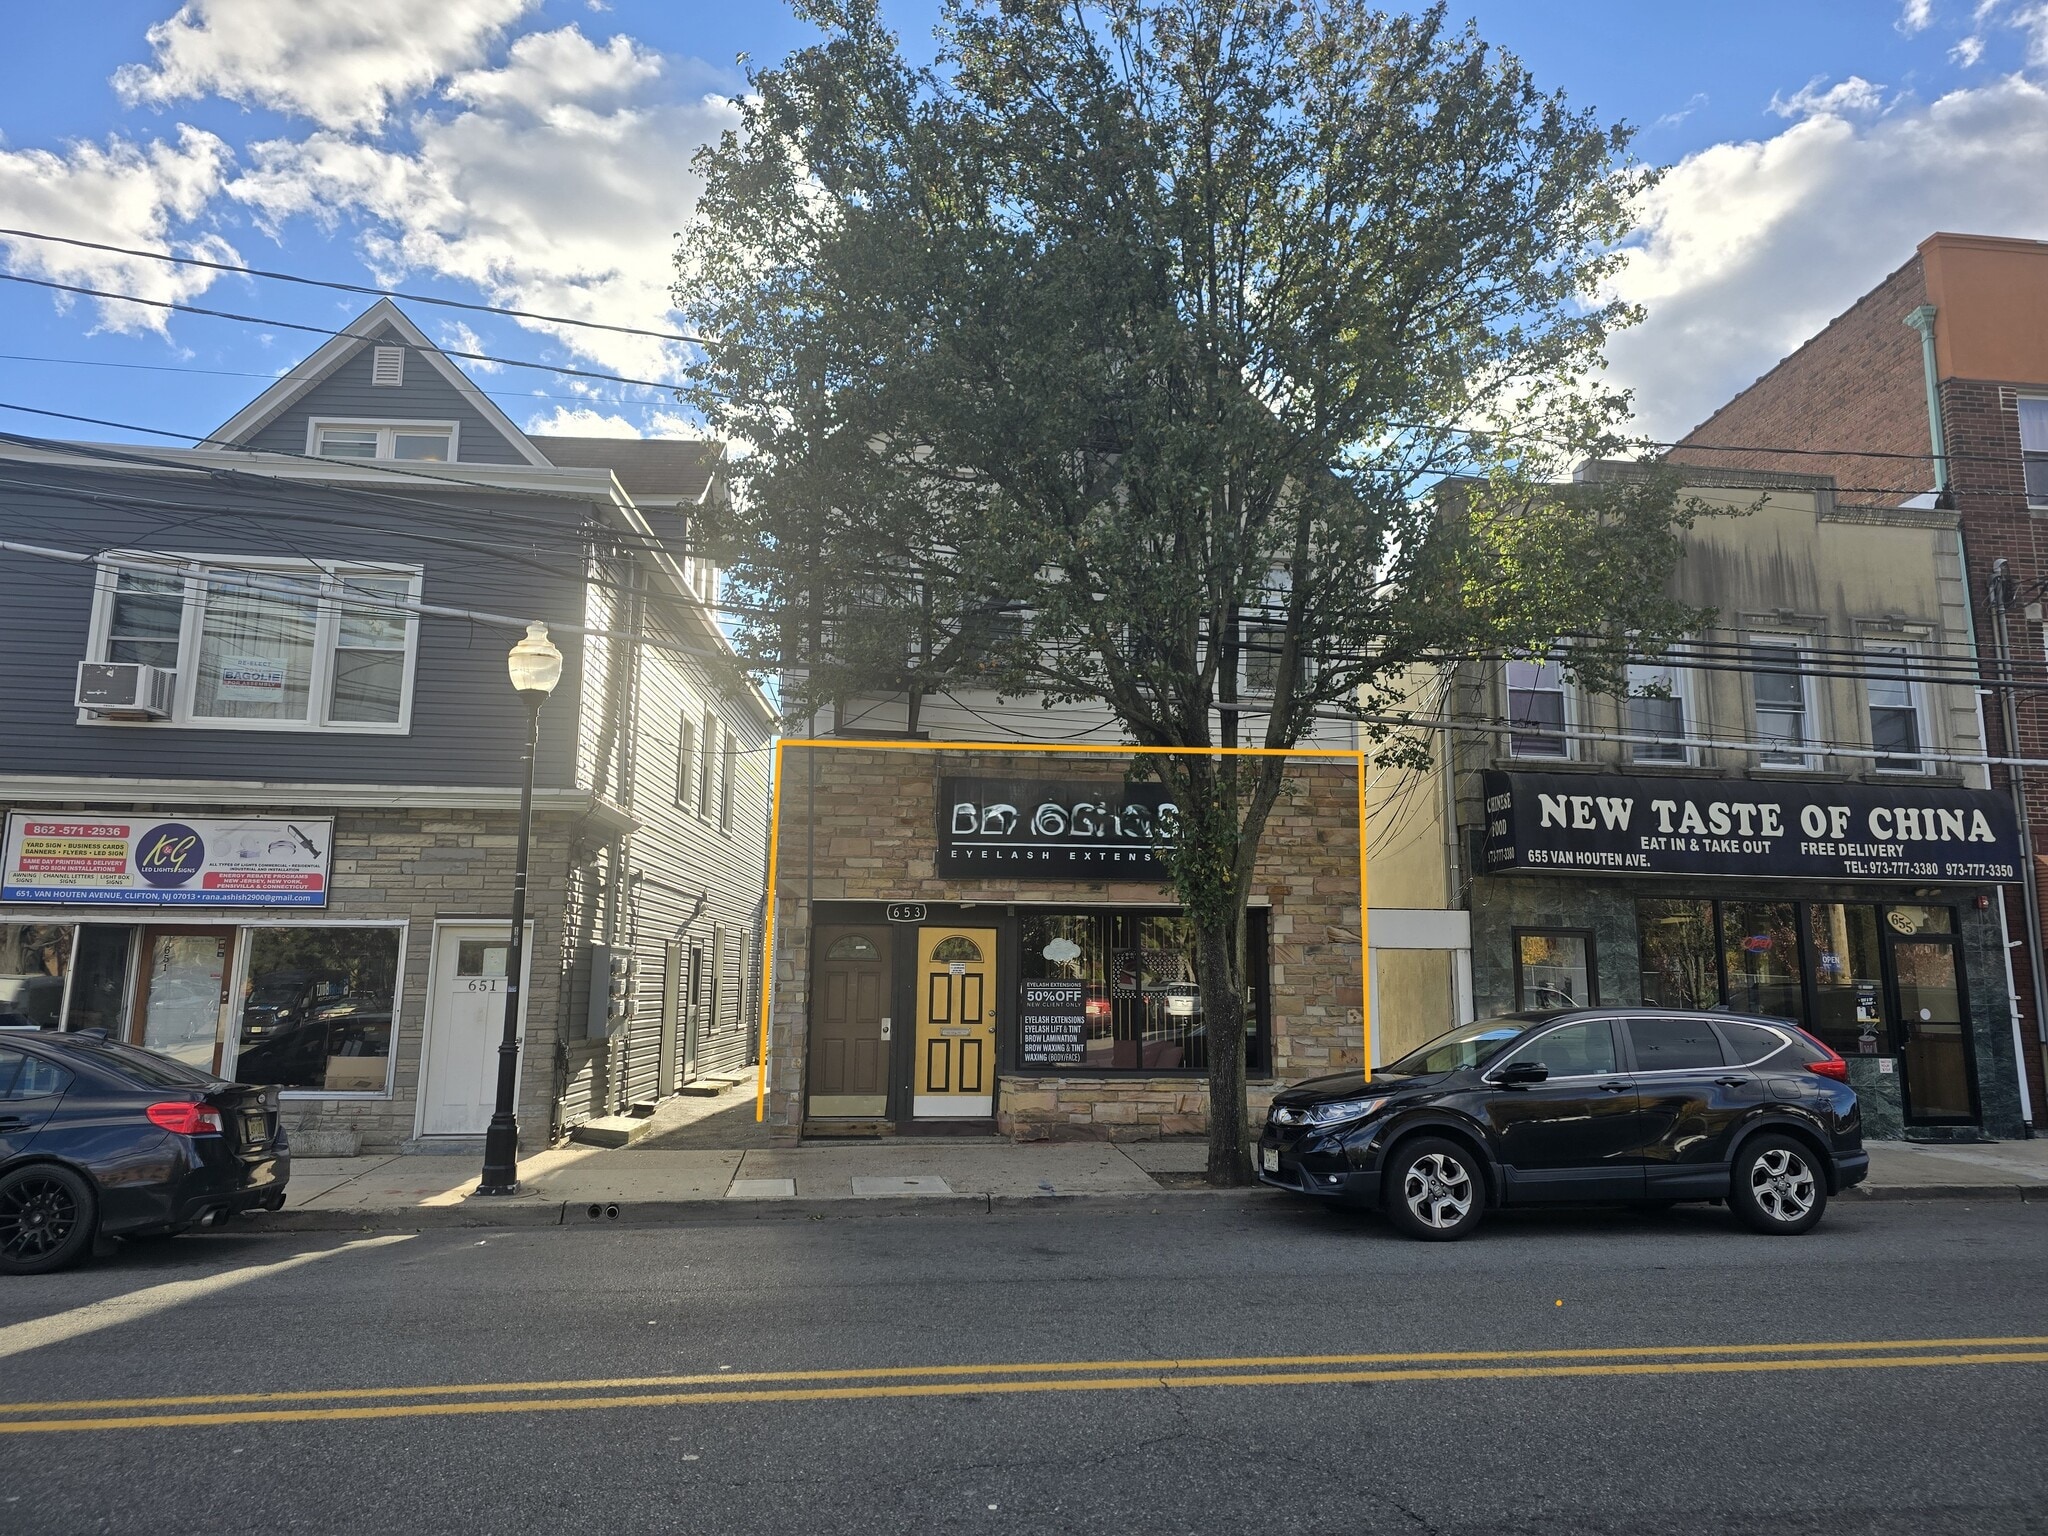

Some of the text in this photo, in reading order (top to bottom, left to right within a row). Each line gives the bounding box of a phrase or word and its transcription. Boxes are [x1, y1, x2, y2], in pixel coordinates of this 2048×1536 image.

[226, 672, 280, 681] BAGOLIE
[1487, 792, 1511, 814] CHINESE
[1537, 794, 1996, 842] NEW TASTE OF CHINA
[34, 826, 120, 836] 862 -571 -2936
[1640, 836, 1771, 854] EAT IN & TAKE OUT
[1800, 842, 1904, 857] FREE DELIVERY
[952, 851, 1049, 860] EYELASH
[1528, 849, 1651, 867] 655 VAN HOUTEN AVE.
[1844, 861, 2013, 877] TEL: 973-777-3380 973-777-3350
[202, 894, 311, 902] rana.ashish2900@gmail.com
[894, 907, 920, 917] 653
[1892, 914, 1913, 933] 655
[1743, 936, 1772, 949] Open
[468, 980, 496, 991] 651
[1027, 991, 1081, 1001] 50%OFF
[1048, 1053, 1080, 1063] (BODY/FACE)
